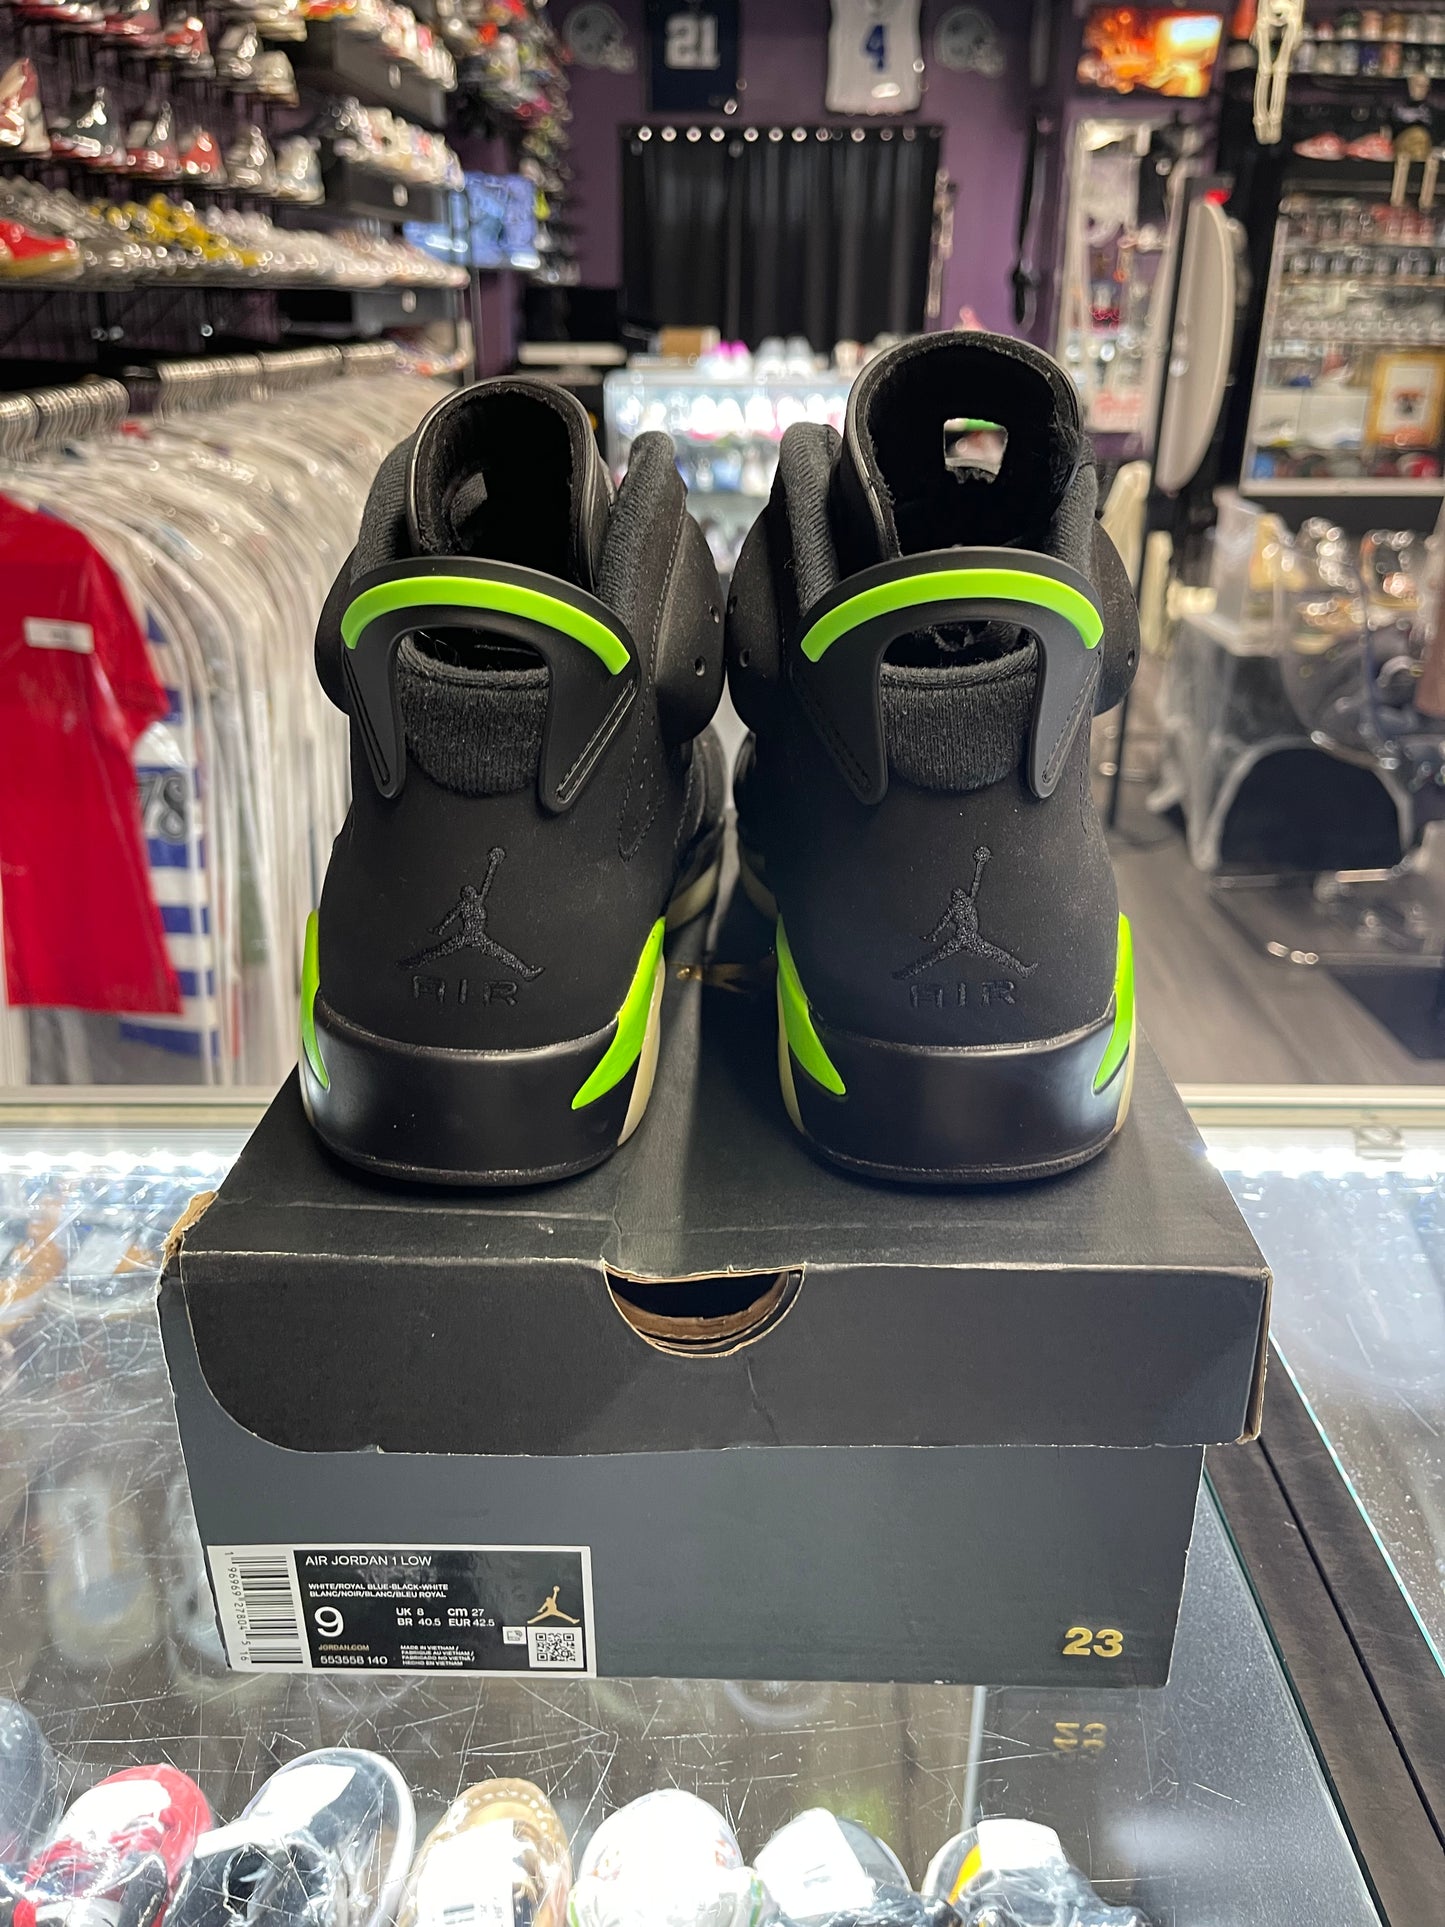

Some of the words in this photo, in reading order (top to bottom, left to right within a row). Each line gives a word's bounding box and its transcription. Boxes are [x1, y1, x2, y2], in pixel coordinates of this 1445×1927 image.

[663, 13, 721, 70] 21
[863, 24, 887, 71] 4
[412, 975, 520, 1006] AIR
[909, 981, 1016, 1008] AIR
[305, 1555, 328, 1566] AIR
[331, 1555, 388, 1566] JORDAN
[392, 1556, 397, 1566] 1
[400, 1555, 432, 1566] LOW
[227, 1566, 243, 1596] 96969
[309, 1590, 418, 1598] BLANC/NOIR/BLANC/BLEU
[367, 1583, 449, 1591] BLUE-BLACK-WHITE
[233, 1602, 248, 1631] 27804
[314, 1606, 344, 1638] 9
[395, 1607, 412, 1616] UK
[416, 1607, 425, 1616] 8
[447, 1607, 468, 1617] cm
[471, 1608, 485, 1617] 27
[397, 1617, 413, 1626] BR
[418, 1617, 442, 1626] 40.5
[448, 1618, 471, 1627] EUR
[472, 1618, 495, 1627] 42.5
[1062, 1626, 1124, 1658] 23
[239, 1650, 250, 1662] 16
[367, 1655, 388, 1665] 140
